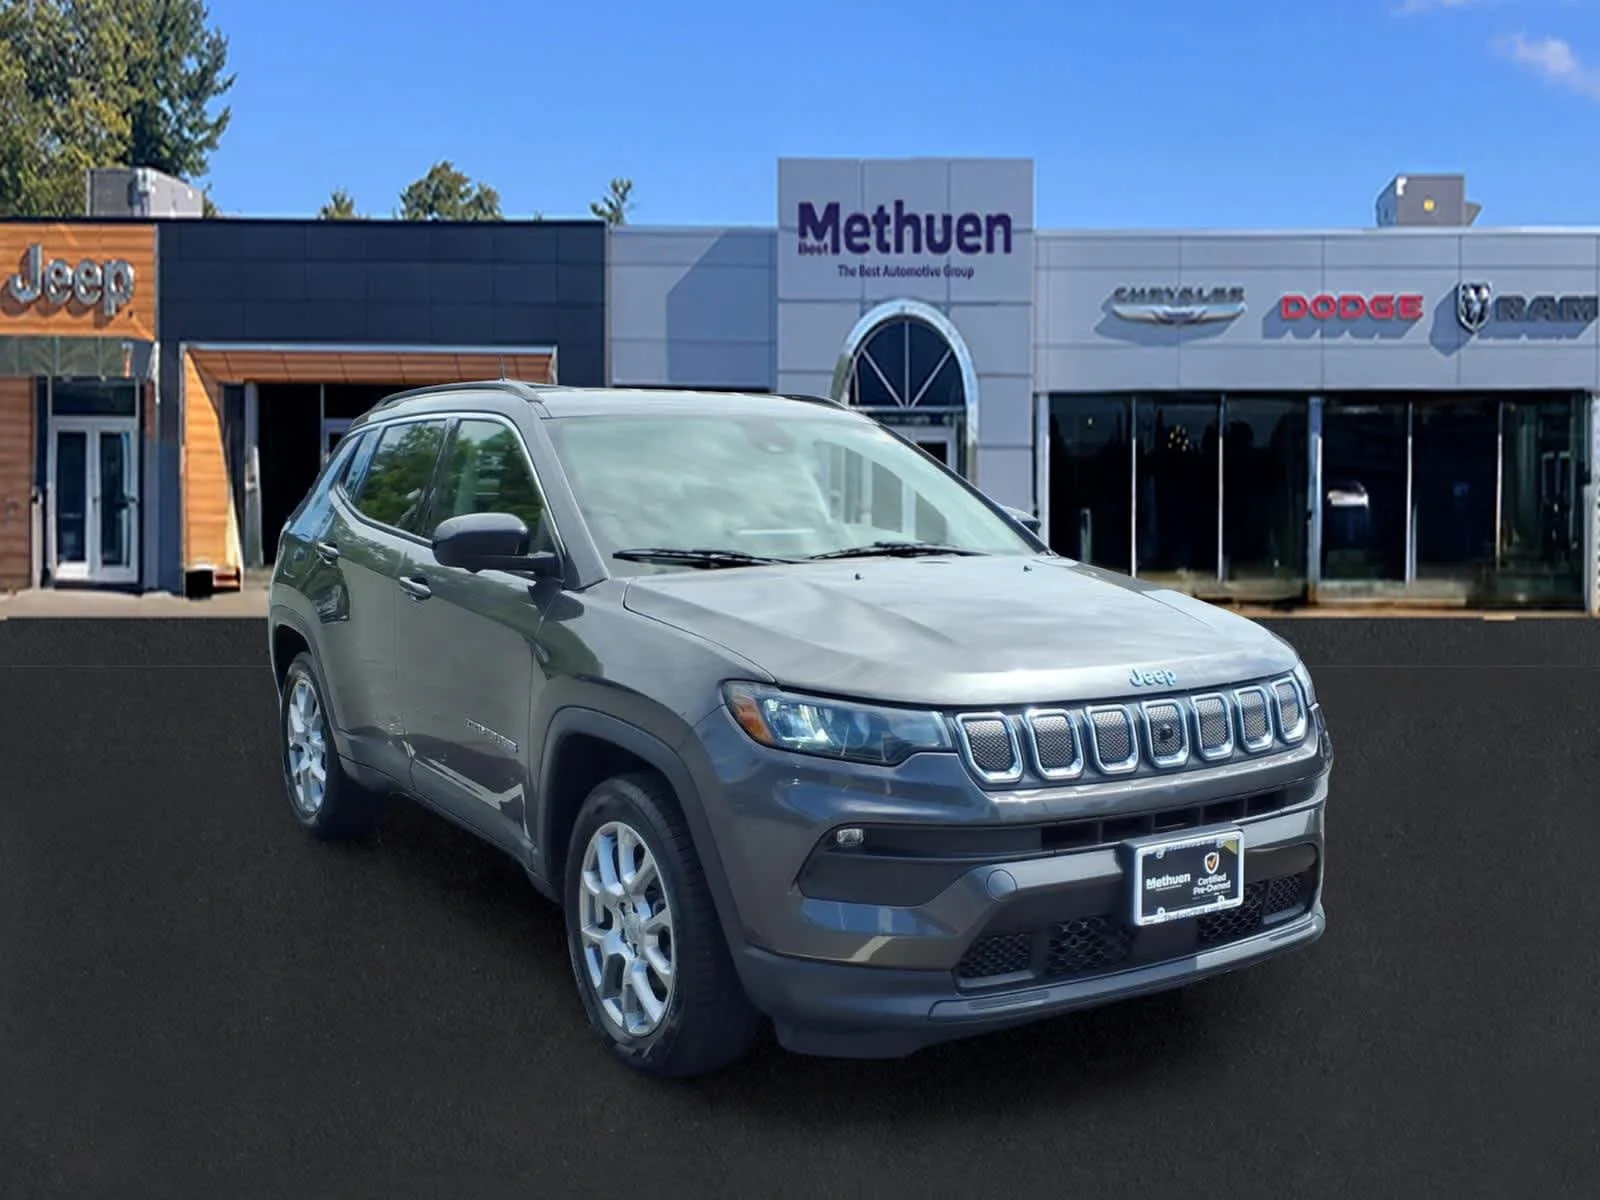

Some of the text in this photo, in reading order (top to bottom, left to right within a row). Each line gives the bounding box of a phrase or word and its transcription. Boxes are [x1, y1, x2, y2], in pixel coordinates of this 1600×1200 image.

[798, 199, 1012, 254] Methuen
[9, 243, 135, 317] Jeep
[838, 264, 975, 280] The Best Automotive Group
[1281, 295, 1423, 320] DODGE
[1495, 295, 1598, 322] RAM
[1129, 664, 1177, 687] Jeep
[1145, 873, 1191, 890] Methuen
